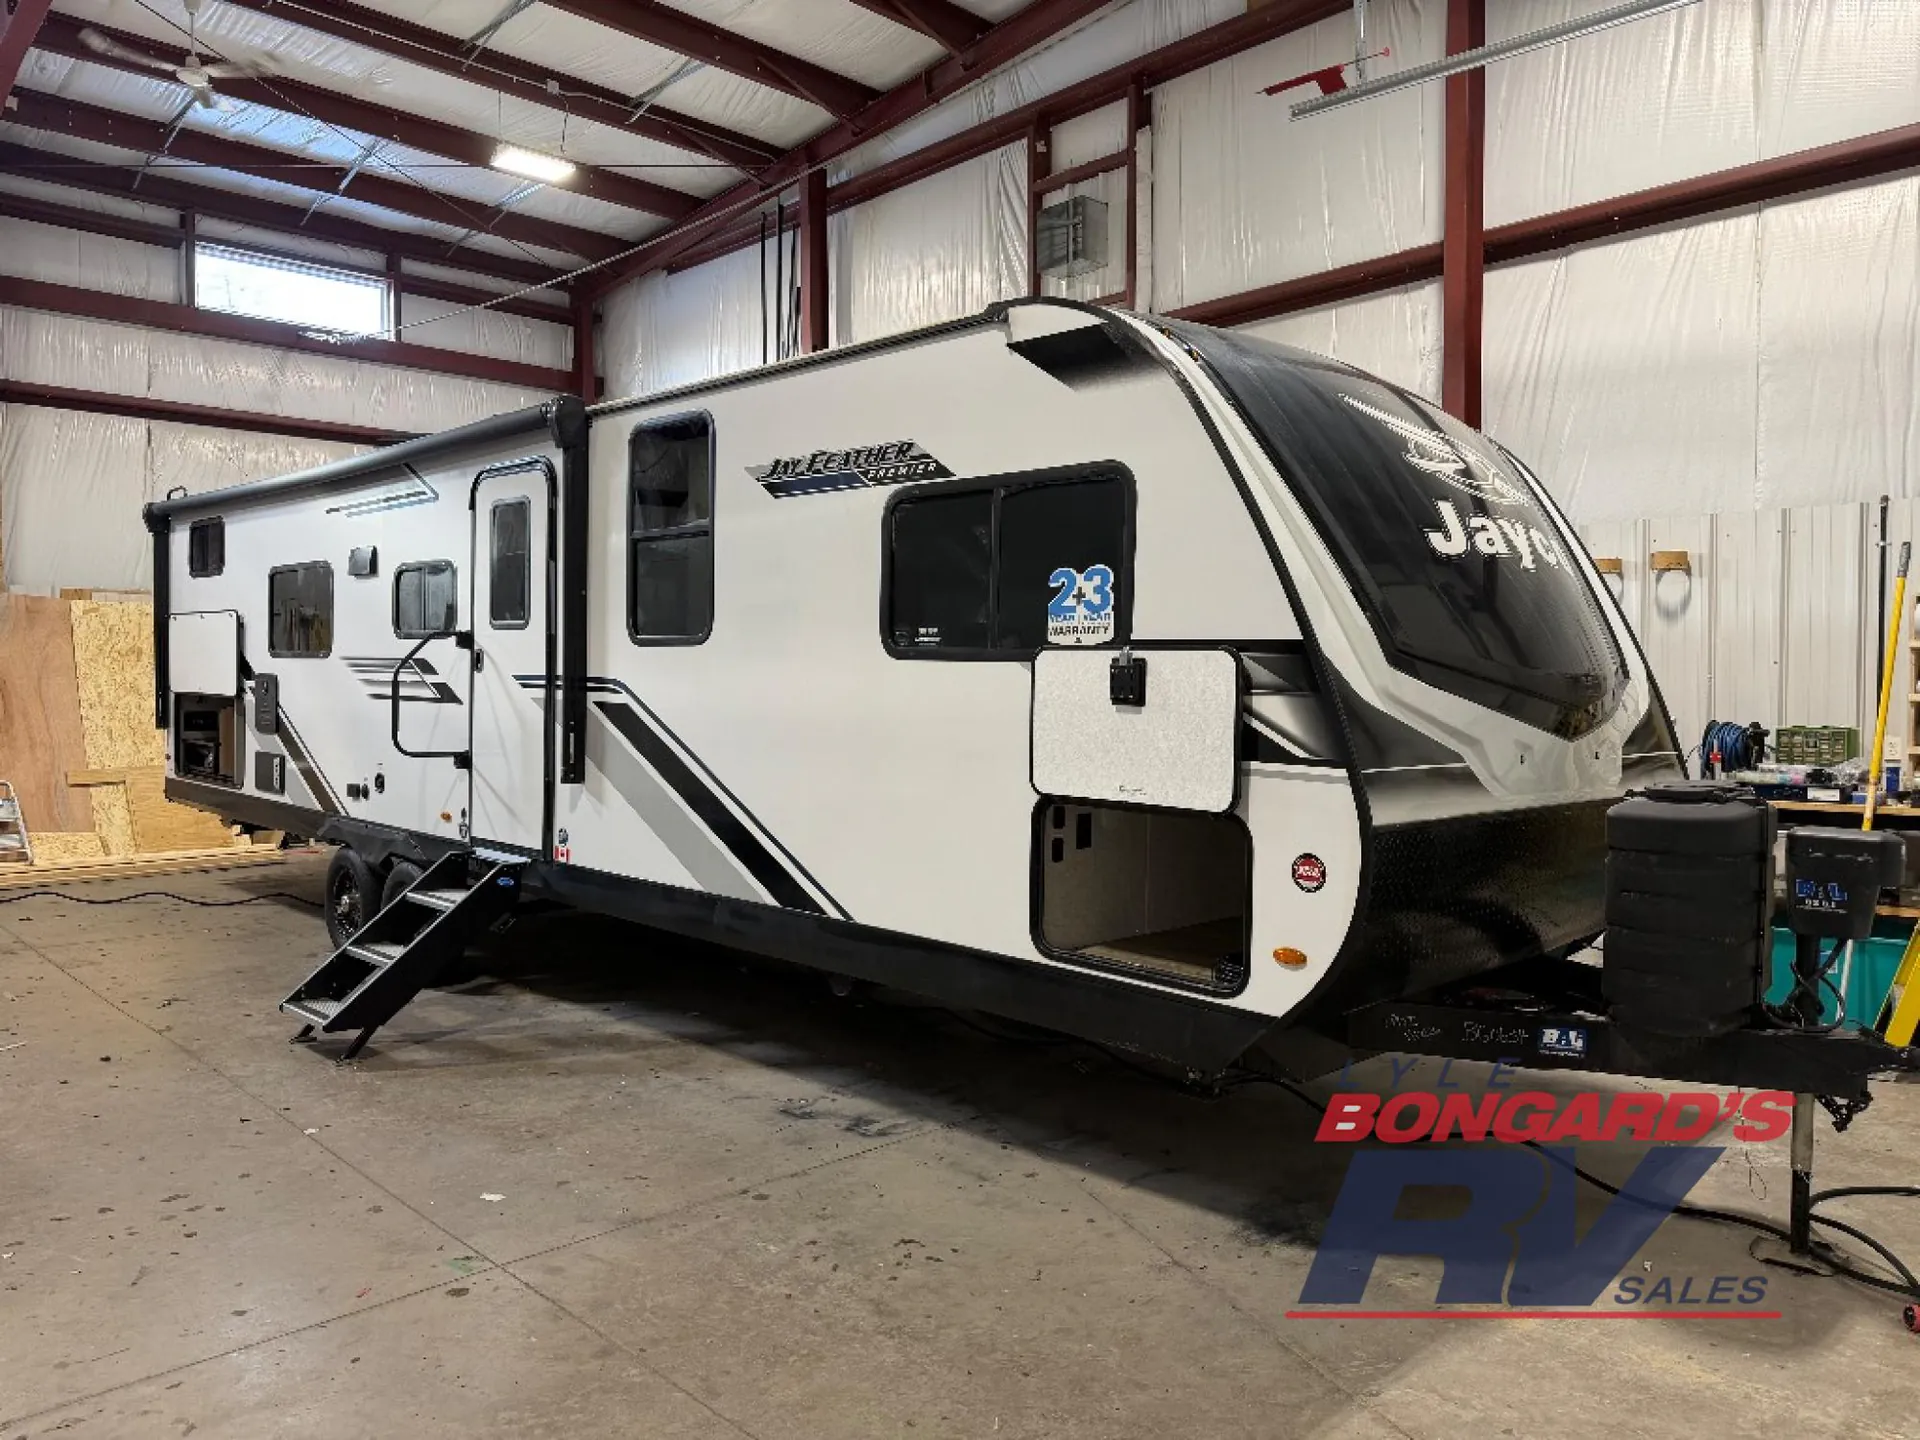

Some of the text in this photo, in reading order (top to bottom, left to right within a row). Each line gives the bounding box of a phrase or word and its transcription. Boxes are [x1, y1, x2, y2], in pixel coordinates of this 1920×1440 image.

[757, 440, 915, 482] JAY FEATHER
[866, 462, 938, 480] PREMIER
[1049, 625, 1109, 636] WARRANTY
